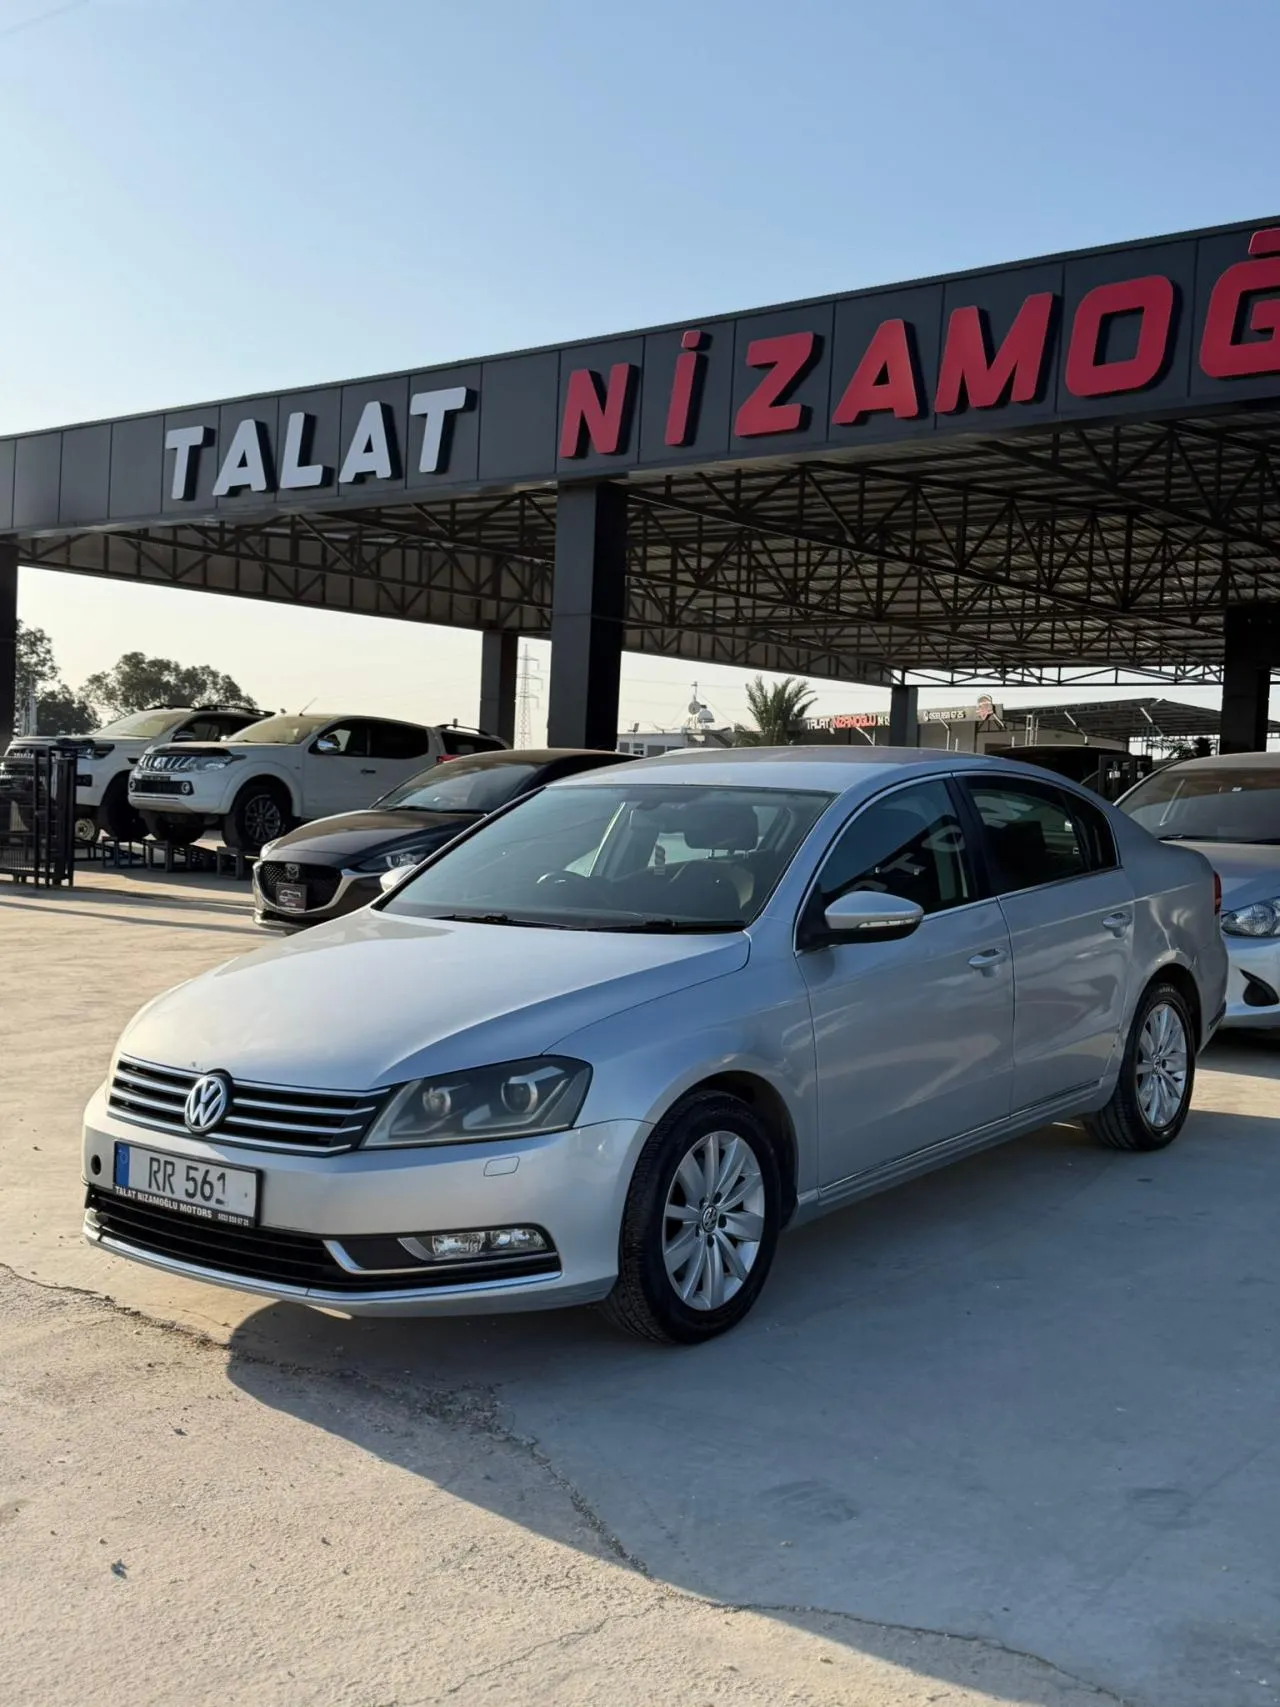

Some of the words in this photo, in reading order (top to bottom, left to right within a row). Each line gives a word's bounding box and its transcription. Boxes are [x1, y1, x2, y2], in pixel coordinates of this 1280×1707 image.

[165, 386, 471, 500] TALAT
[806, 718, 830, 729] TALAT
[148, 1156, 176, 1195] RR
[184, 1164, 227, 1205] 561
[115, 1185, 137, 1199] TALAT
[179, 1202, 213, 1219] MOTORS
